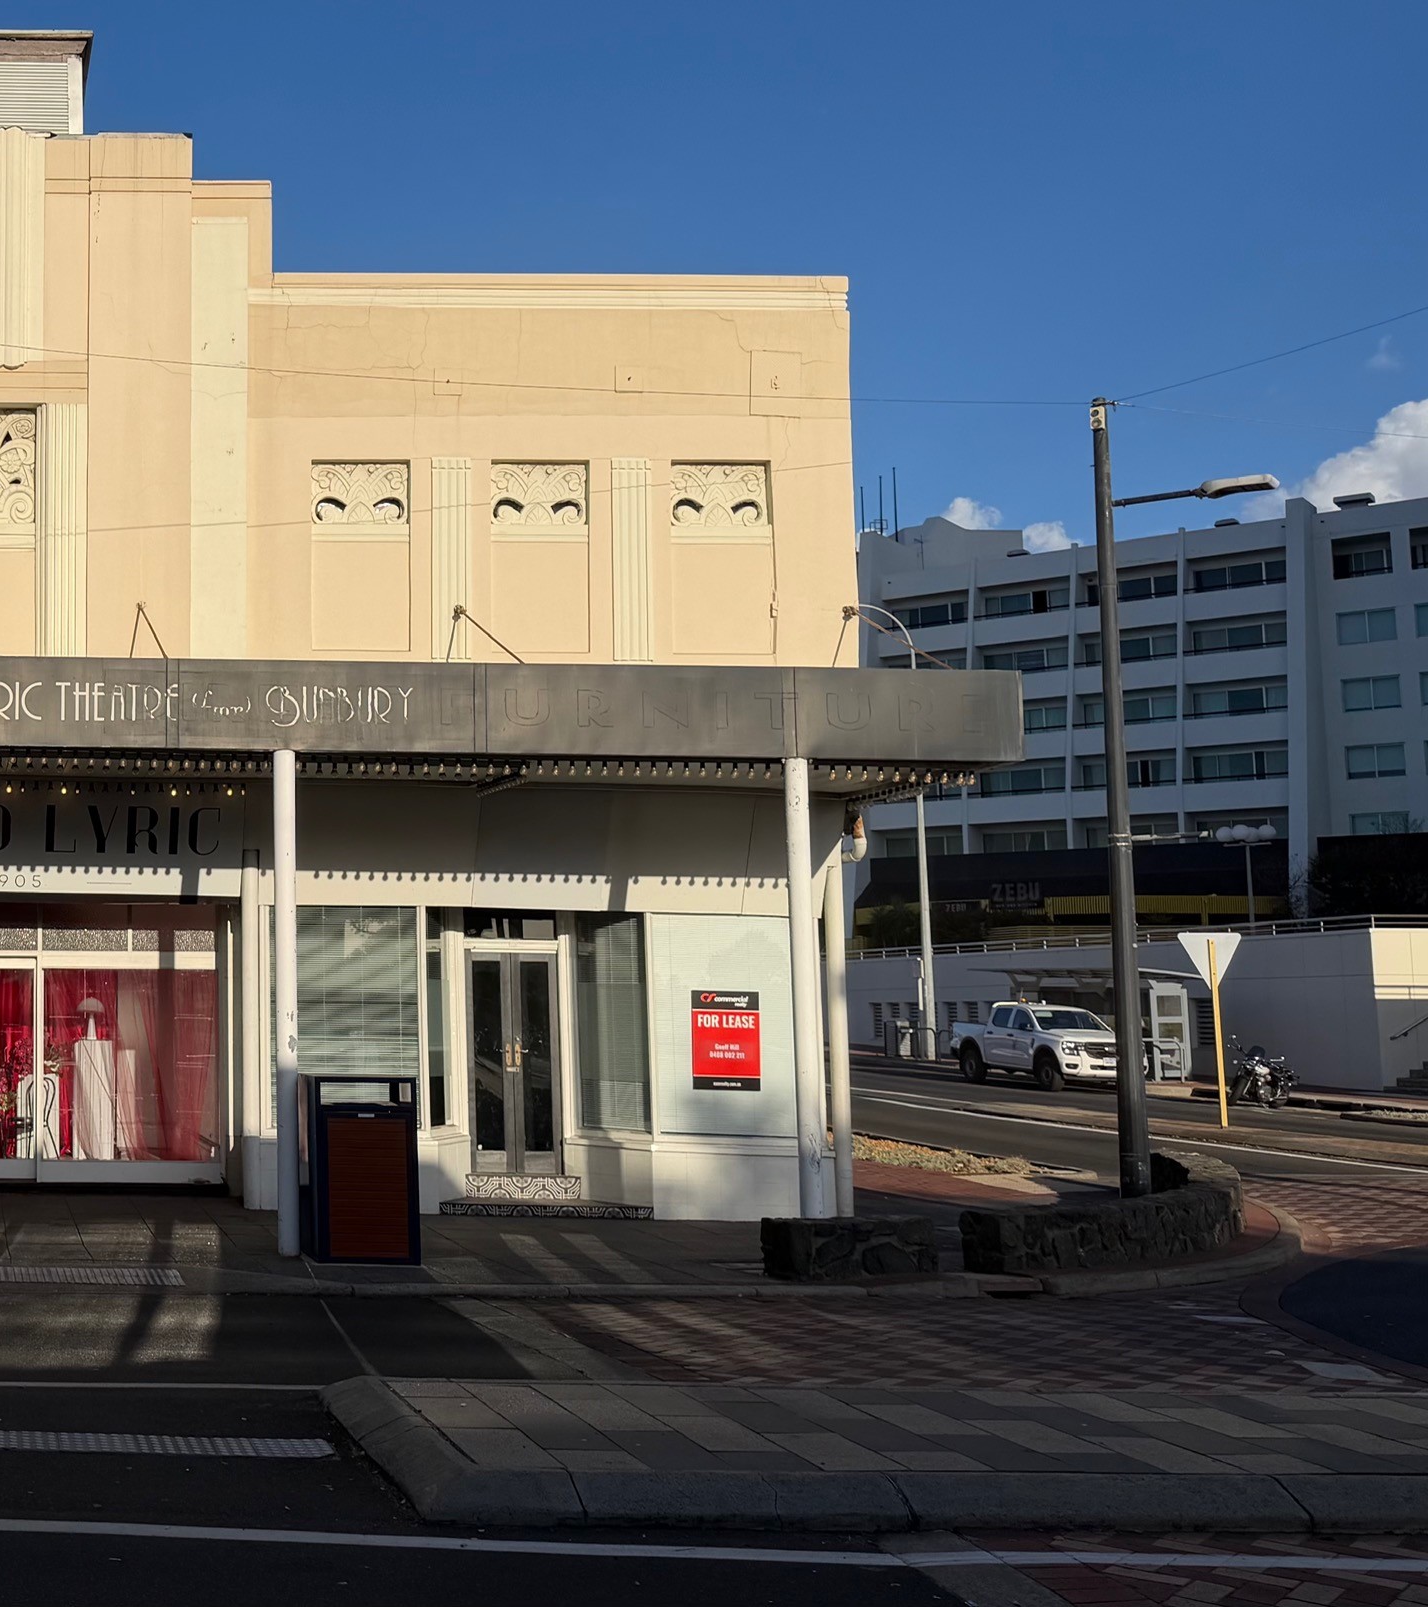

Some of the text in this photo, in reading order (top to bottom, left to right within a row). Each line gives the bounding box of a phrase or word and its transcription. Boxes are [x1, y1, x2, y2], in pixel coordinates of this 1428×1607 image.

[55, 681, 179, 722] THEATRE
[266, 685, 414, 728] BUNBURY
[45, 804, 221, 856] LYRIC
[992, 882, 1040, 901] ZEBU
[945, 903, 967, 912] ZEBU
[714, 995, 748, 1003] commercial
[697, 1014, 755, 1029] FOR LEASE
